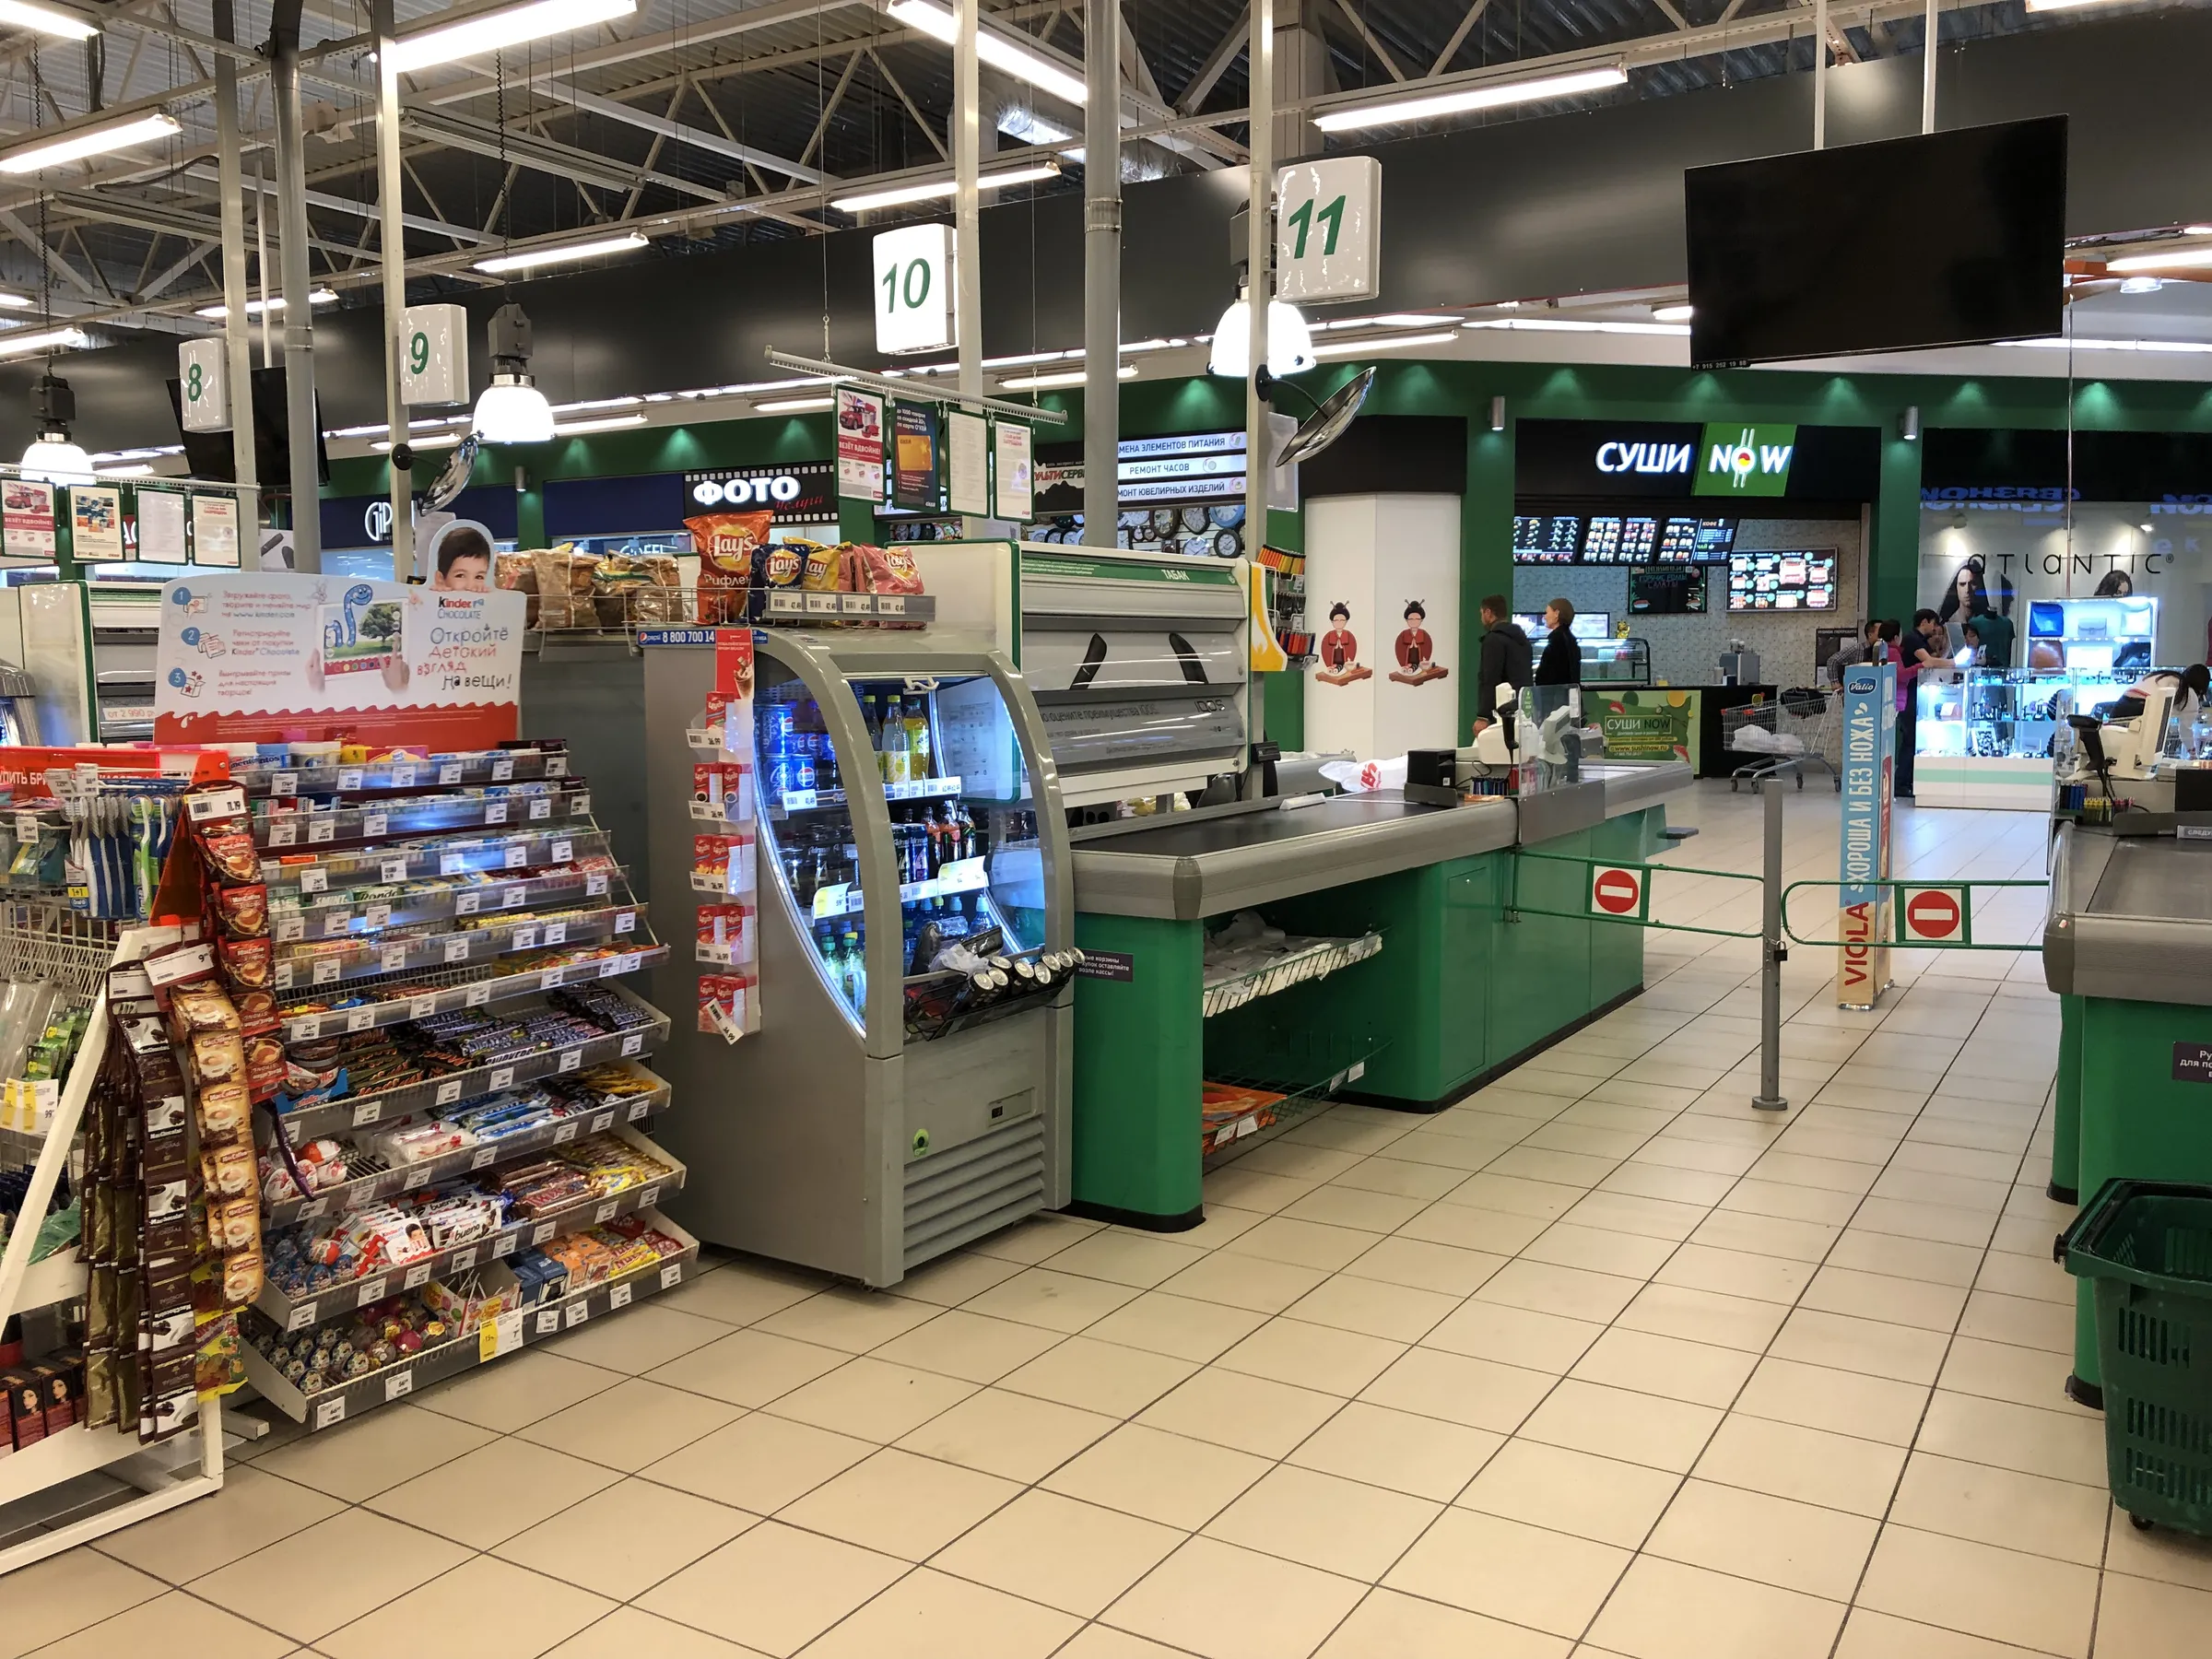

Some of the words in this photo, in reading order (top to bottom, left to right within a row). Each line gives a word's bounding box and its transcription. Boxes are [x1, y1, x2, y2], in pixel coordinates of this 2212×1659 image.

[1288, 194, 1347, 259] 11
[882, 257, 931, 315] 10
[408, 331, 429, 375] 9
[187, 363, 203, 402] 8
[1118, 445, 1140, 454] МЕНА
[1142, 441, 1187, 453] ЭЛЕМЕНТОВ
[1189, 438, 1226, 449] ПИТАНИЯ
[1595, 441, 1693, 474] СУШИ
[1708, 441, 1794, 476] NOW
[1034, 469, 1085, 481] УЛЬТИСЕРВ
[1129, 465, 1162, 475] РЕМОНТ
[1163, 463, 1190, 473] ЧАСОВ
[693, 476, 802, 505] ФОТО
[1118, 488, 1136, 498] МОНТ
[1139, 485, 1187, 496] ЮВЕЛИРНЫХ
[1189, 481, 1225, 494] ИЗДЕЛИЙ
[713, 533, 754, 562] Lay's
[770, 556, 800, 577] Lay's
[805, 559, 827, 580] Lay
[1161, 569, 1190, 581] ТАБАК
[703, 573, 751, 587] Рифлен
[179, 591, 183, 600] 1
[187, 630, 194, 641] 2
[663, 631, 668, 643] 8
[670, 631, 686, 643] 800
[688, 630, 703, 642] 700
[174, 673, 182, 683] 3
[1850, 682, 1874, 690] Valio
[1049, 709, 1084, 724] оцените
[1085, 705, 1139, 722] преимущества
[1606, 719, 1641, 730] СУШИ
[1643, 719, 1671, 730] NOW
[1849, 767, 1874, 796] БЕЗ
[1848, 800, 1873, 813] И
[1844, 901, 1870, 986] VIOLA
[2180, 1058, 2200, 1067] для
[454, 1223, 481, 1241] bueno
